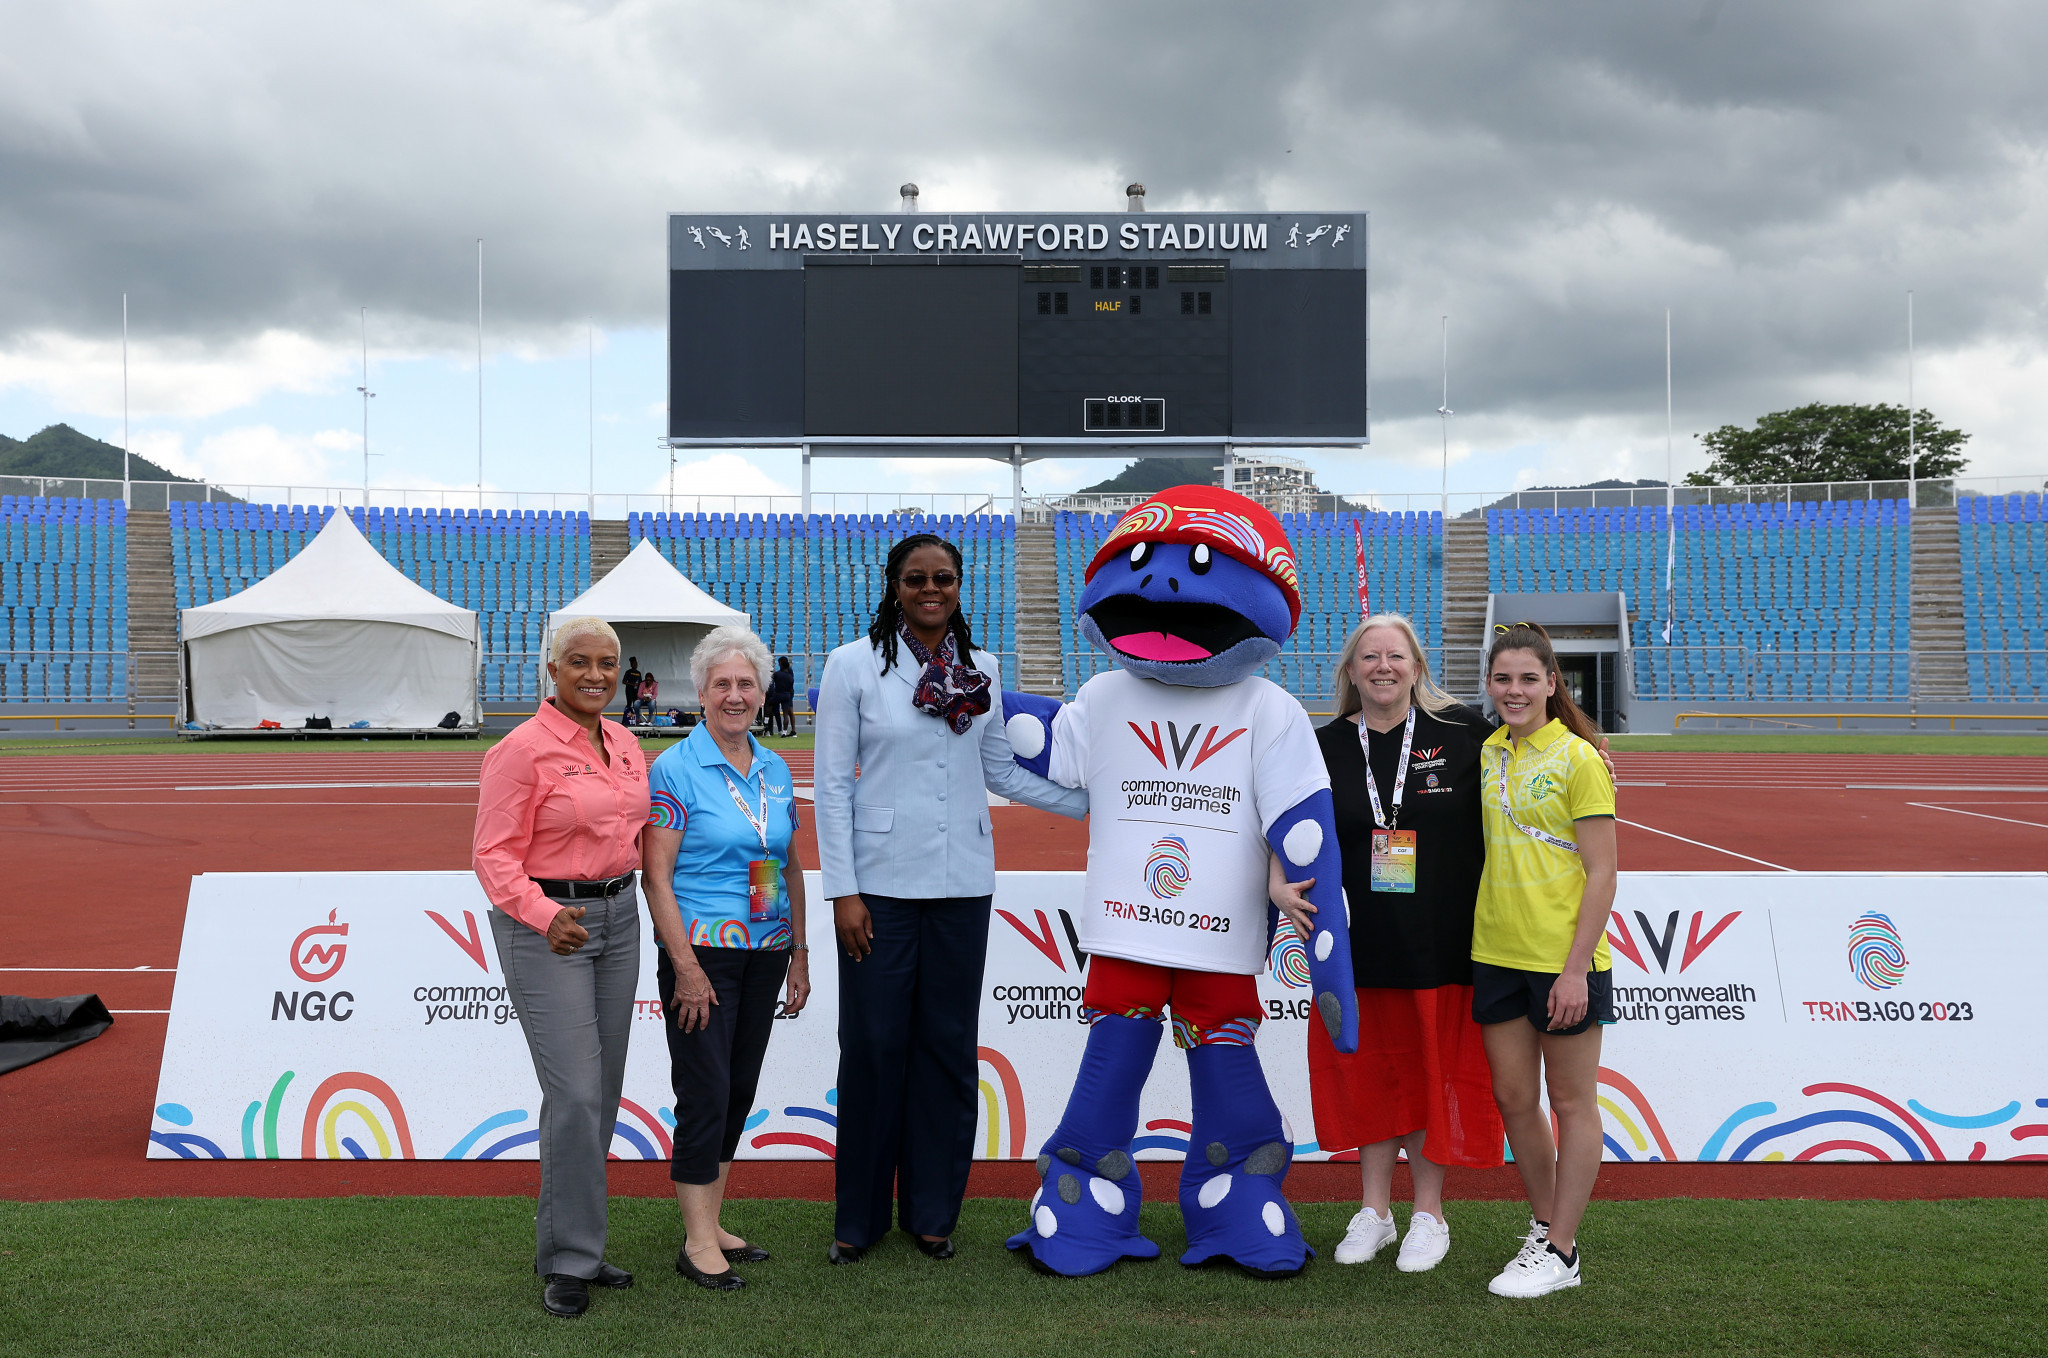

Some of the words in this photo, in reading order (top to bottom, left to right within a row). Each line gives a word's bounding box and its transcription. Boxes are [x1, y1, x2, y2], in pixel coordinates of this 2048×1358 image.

[769, 223, 902, 250] HASELY
[912, 223, 1109, 250] CRAWFORD
[1119, 222, 1268, 250] STADIUM
[1095, 301, 1121, 311] HALF
[1107, 395, 1142, 403] CLOCK
[1121, 779, 1241, 802] commonwealth
[1126, 792, 1167, 810] youth
[1171, 794, 1231, 815] games
[1188, 913, 1231, 933] 2023
[1612, 984, 1756, 1002] mmonwealth
[271, 990, 355, 1022] NGC
[424, 1001, 489, 1025] youth
[1006, 1001, 1071, 1025] youth
[1612, 1002, 1660, 1021] outh
[1664, 1004, 1746, 1026] games
[1919, 1002, 1974, 1021] 2023
